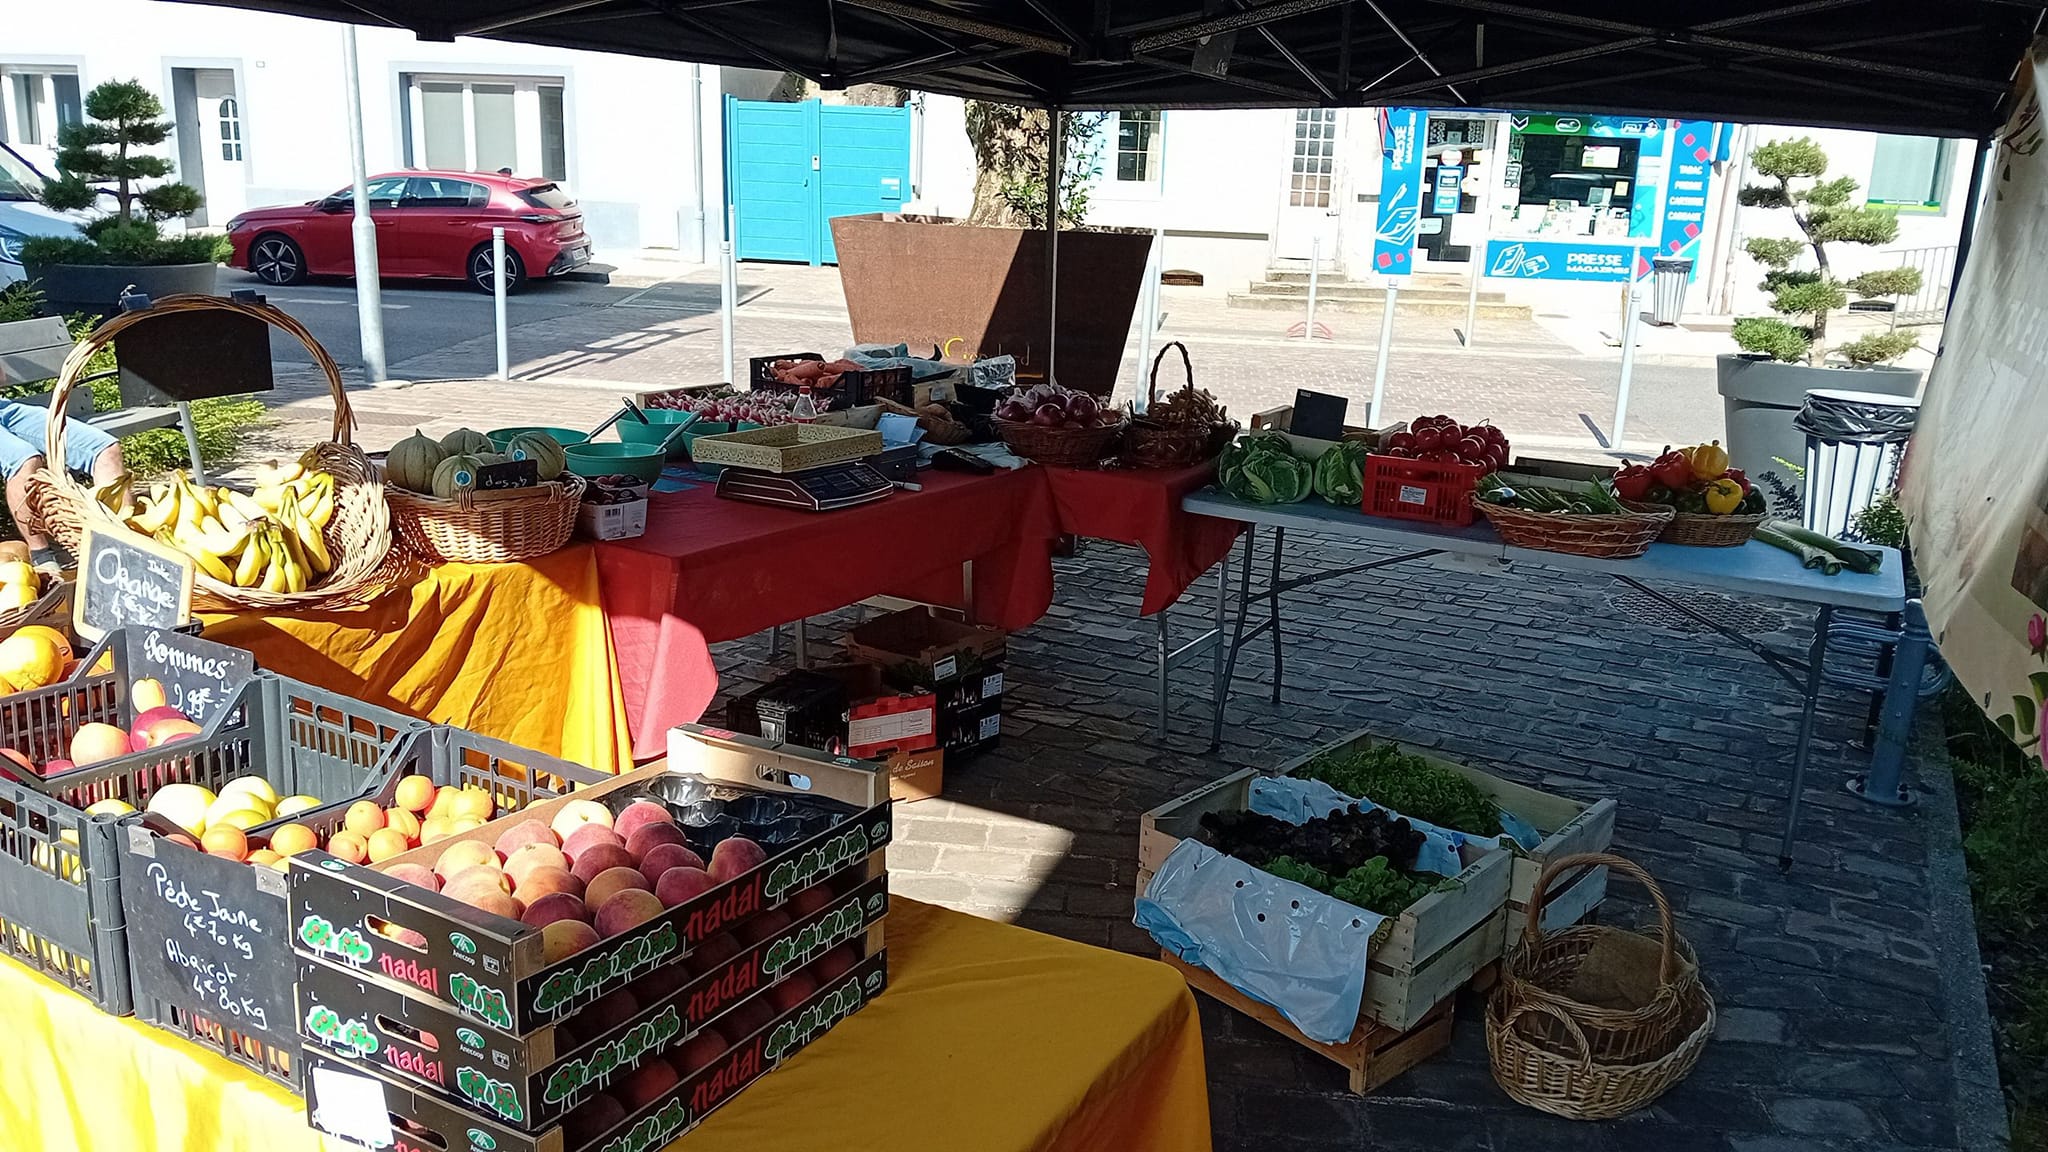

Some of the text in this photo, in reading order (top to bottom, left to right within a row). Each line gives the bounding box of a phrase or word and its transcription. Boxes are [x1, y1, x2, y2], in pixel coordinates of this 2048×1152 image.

[1566, 265, 1630, 274] MAGAZINES
[1567, 253, 1622, 266] PRESSE
[144, 630, 229, 680] Pommes
[202, 890, 262, 933] Jaune
[684, 872, 761, 941] nadal
[378, 952, 440, 995] nadal
[686, 950, 759, 1022] nadal
[383, 1043, 445, 1087] nadal
[691, 1036, 761, 1112] nadal
